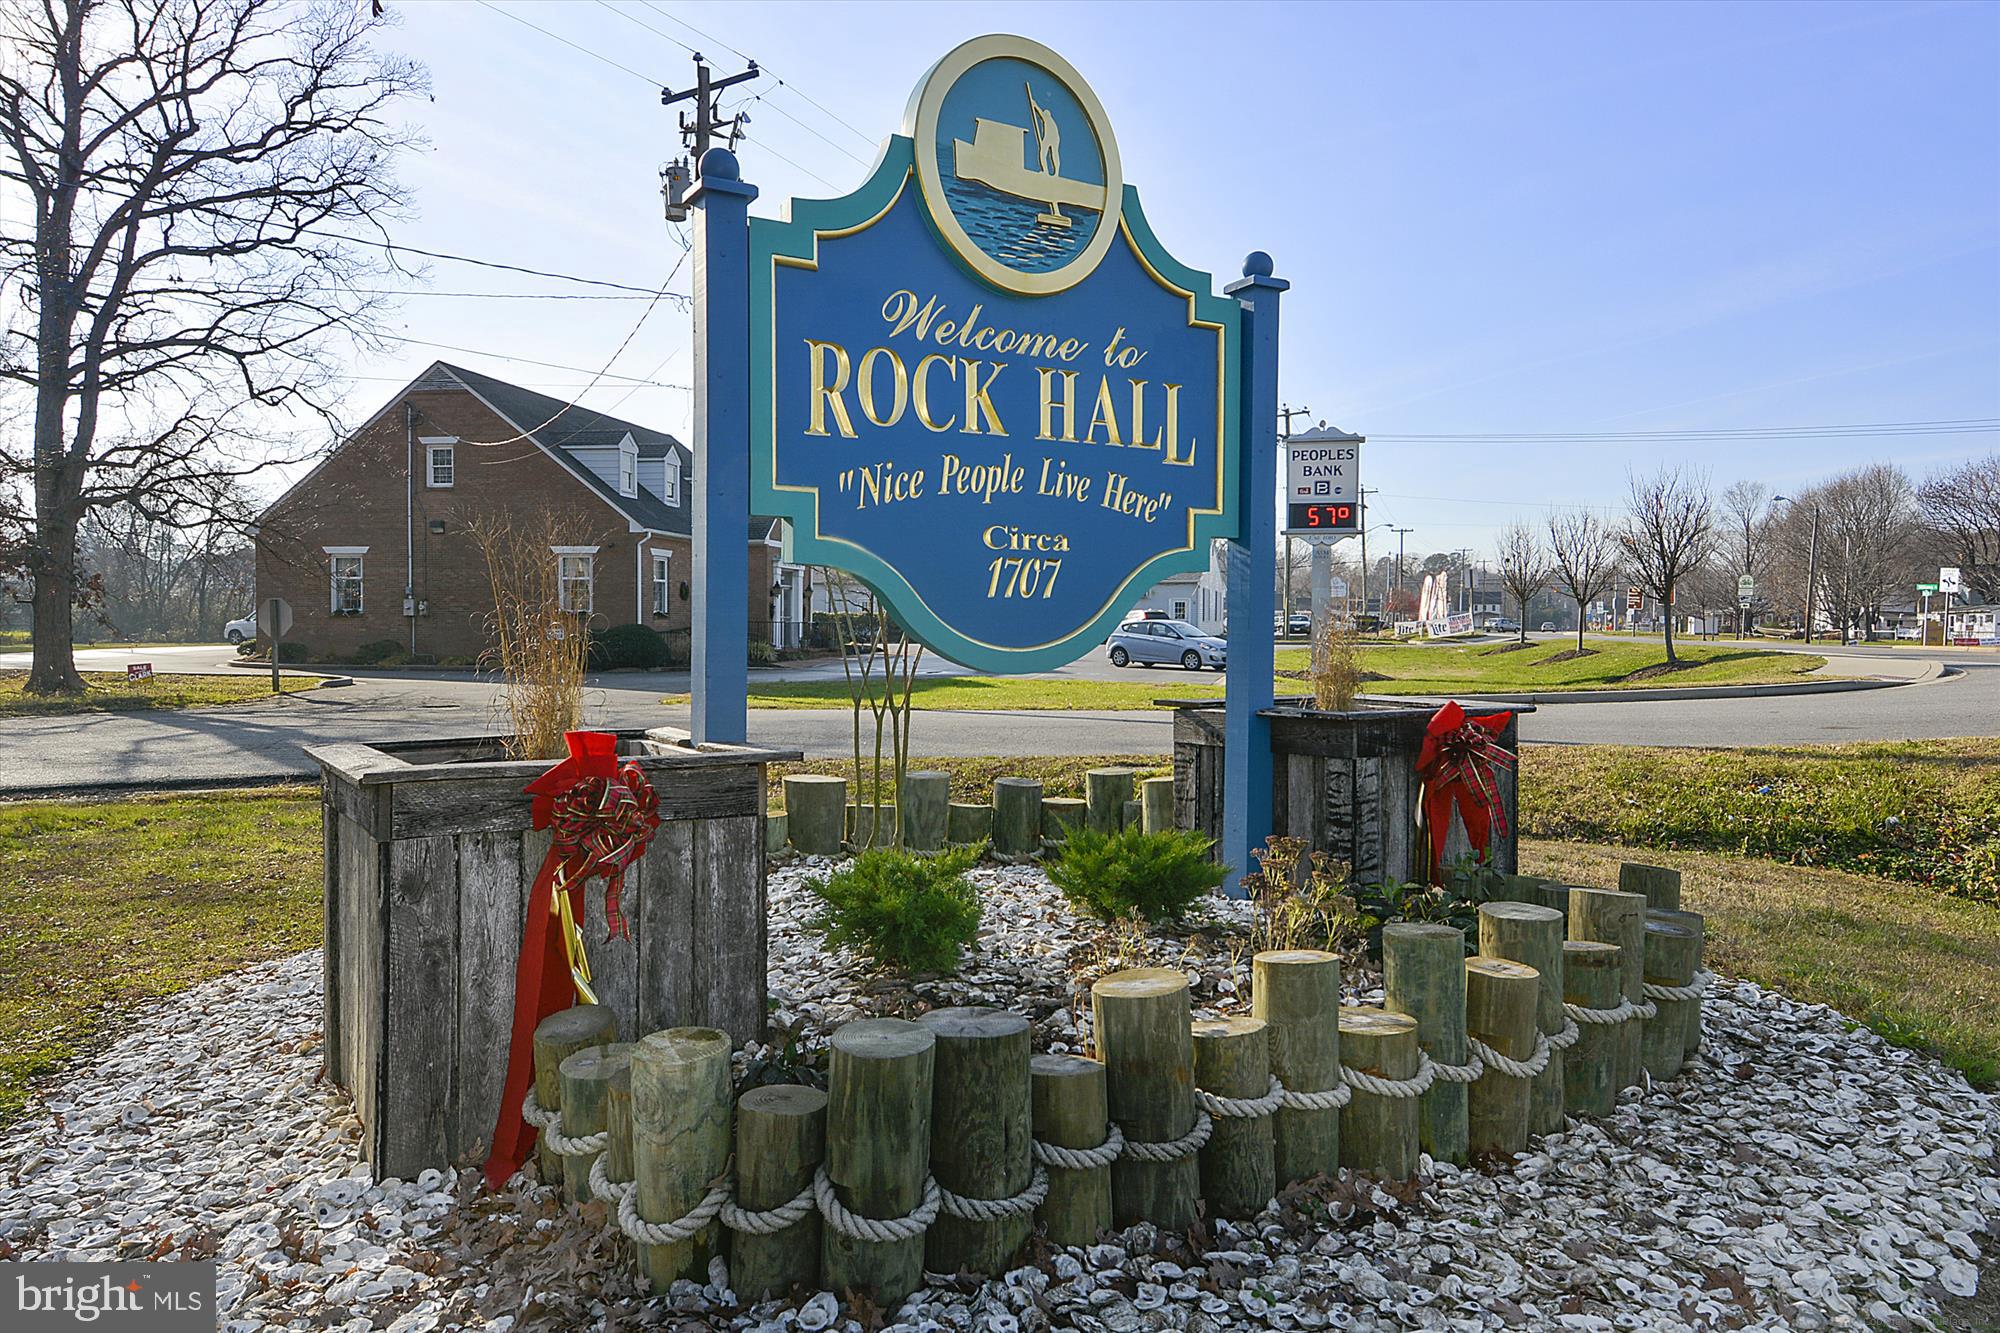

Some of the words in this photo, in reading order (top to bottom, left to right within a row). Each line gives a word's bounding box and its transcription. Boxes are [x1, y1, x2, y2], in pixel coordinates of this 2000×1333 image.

[882, 289, 1088, 362] Welcome
[1104, 326, 1148, 368] to
[803, 338, 1010, 439] ROCK
[1034, 366, 1196, 467] HALL
[1292, 449, 1354, 461] PEOPLES
[1303, 465, 1343, 477] BANK
[838, 461, 924, 510] "Nice
[938, 453, 1024, 504] People
[1037, 456, 1092, 502] Live
[1100, 471, 1172, 523] Here"
[982, 525, 1070, 552] Circa
[987, 557, 1062, 599] 1707
